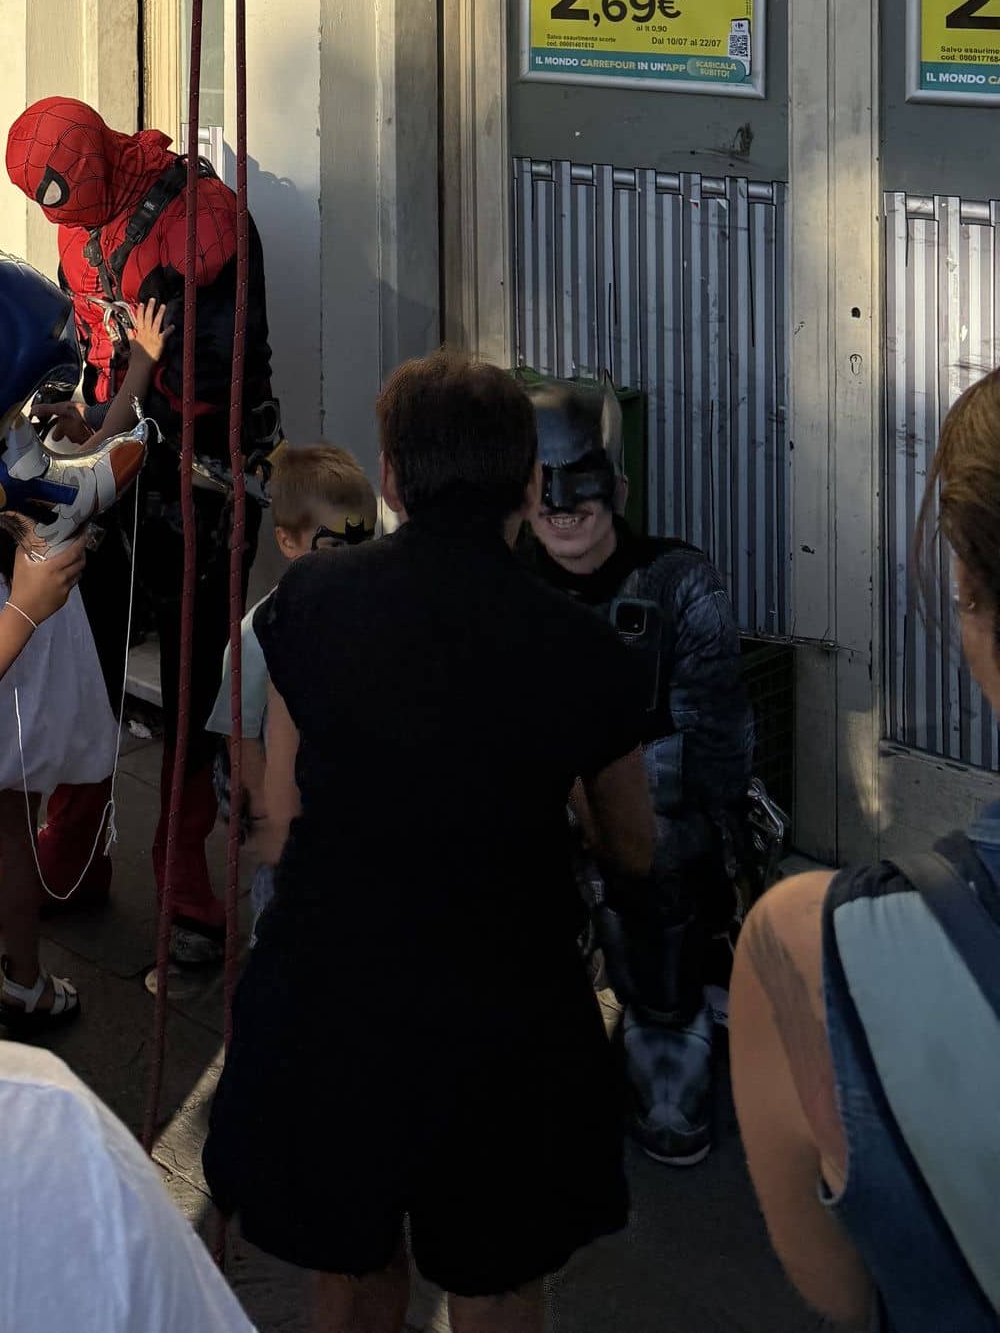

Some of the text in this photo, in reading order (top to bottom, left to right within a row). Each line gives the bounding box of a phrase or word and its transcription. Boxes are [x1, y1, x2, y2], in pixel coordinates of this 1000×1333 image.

[651, 37, 722, 48] Dal 10/07 al 22/07
[535, 56, 544, 65] IL
[544, 56, 579, 67] MONDO
[580, 58, 636, 70] CARREFOUR
[637, 61, 649, 70] IN
[695, 60, 737, 71] SCARICALA
[926, 72, 937, 82] IL
[939, 73, 986, 84] MONDO
